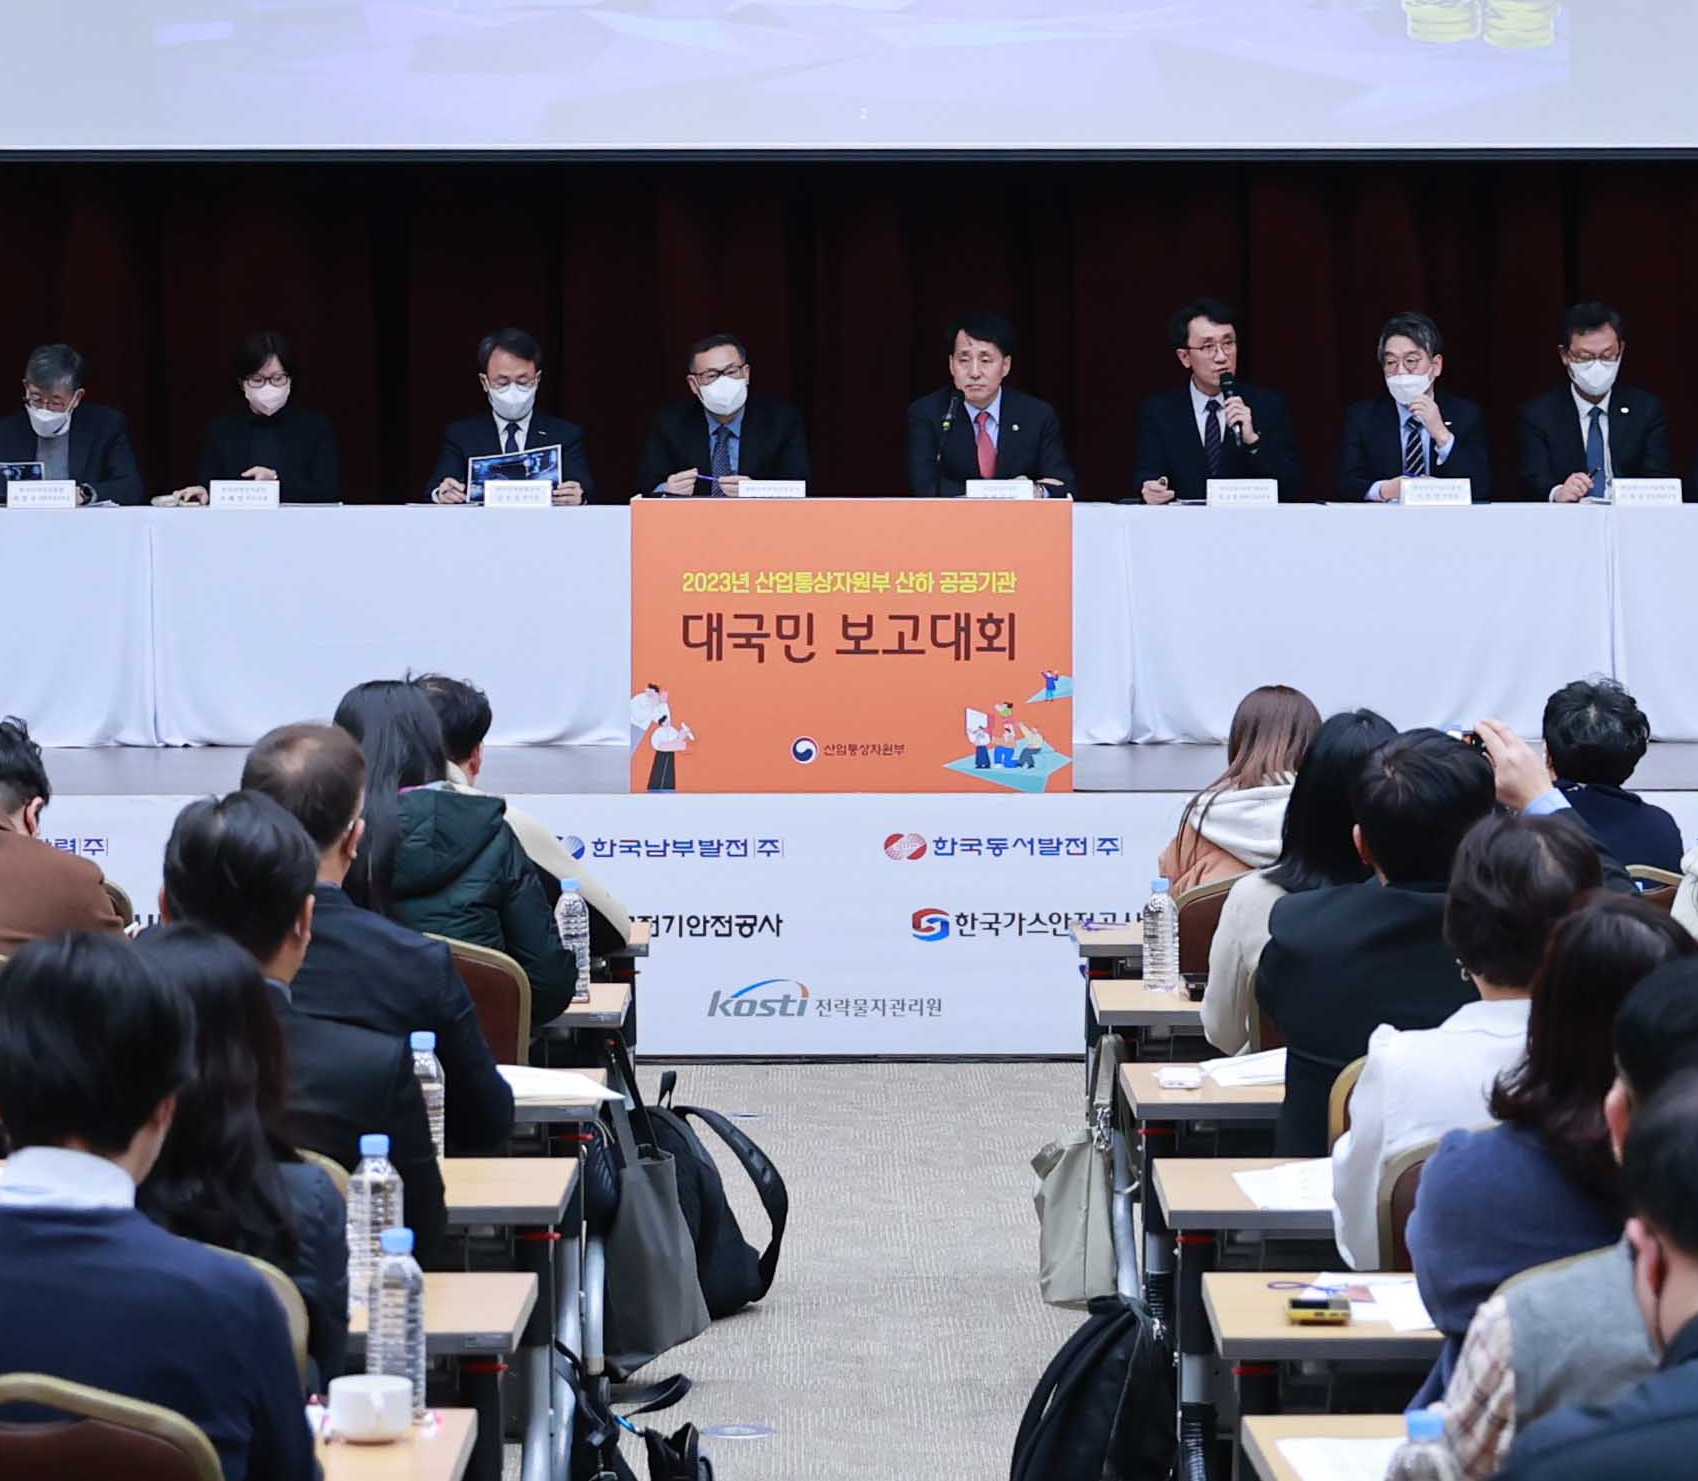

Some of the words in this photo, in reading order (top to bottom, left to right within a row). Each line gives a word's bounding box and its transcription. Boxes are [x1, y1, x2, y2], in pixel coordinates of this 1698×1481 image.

[682, 571, 750, 594] 2023년
[755, 571, 890, 594] 산업통상자원부
[895, 571, 934, 594] 산하
[939, 571, 1017, 594] 공공기관
[682, 612, 816, 663] 대국민
[835, 612, 1016, 661] 보고대회
[823, 743, 905, 757] 산업통상자원부
[815, 997, 942, 1017] 전략물자관리원
